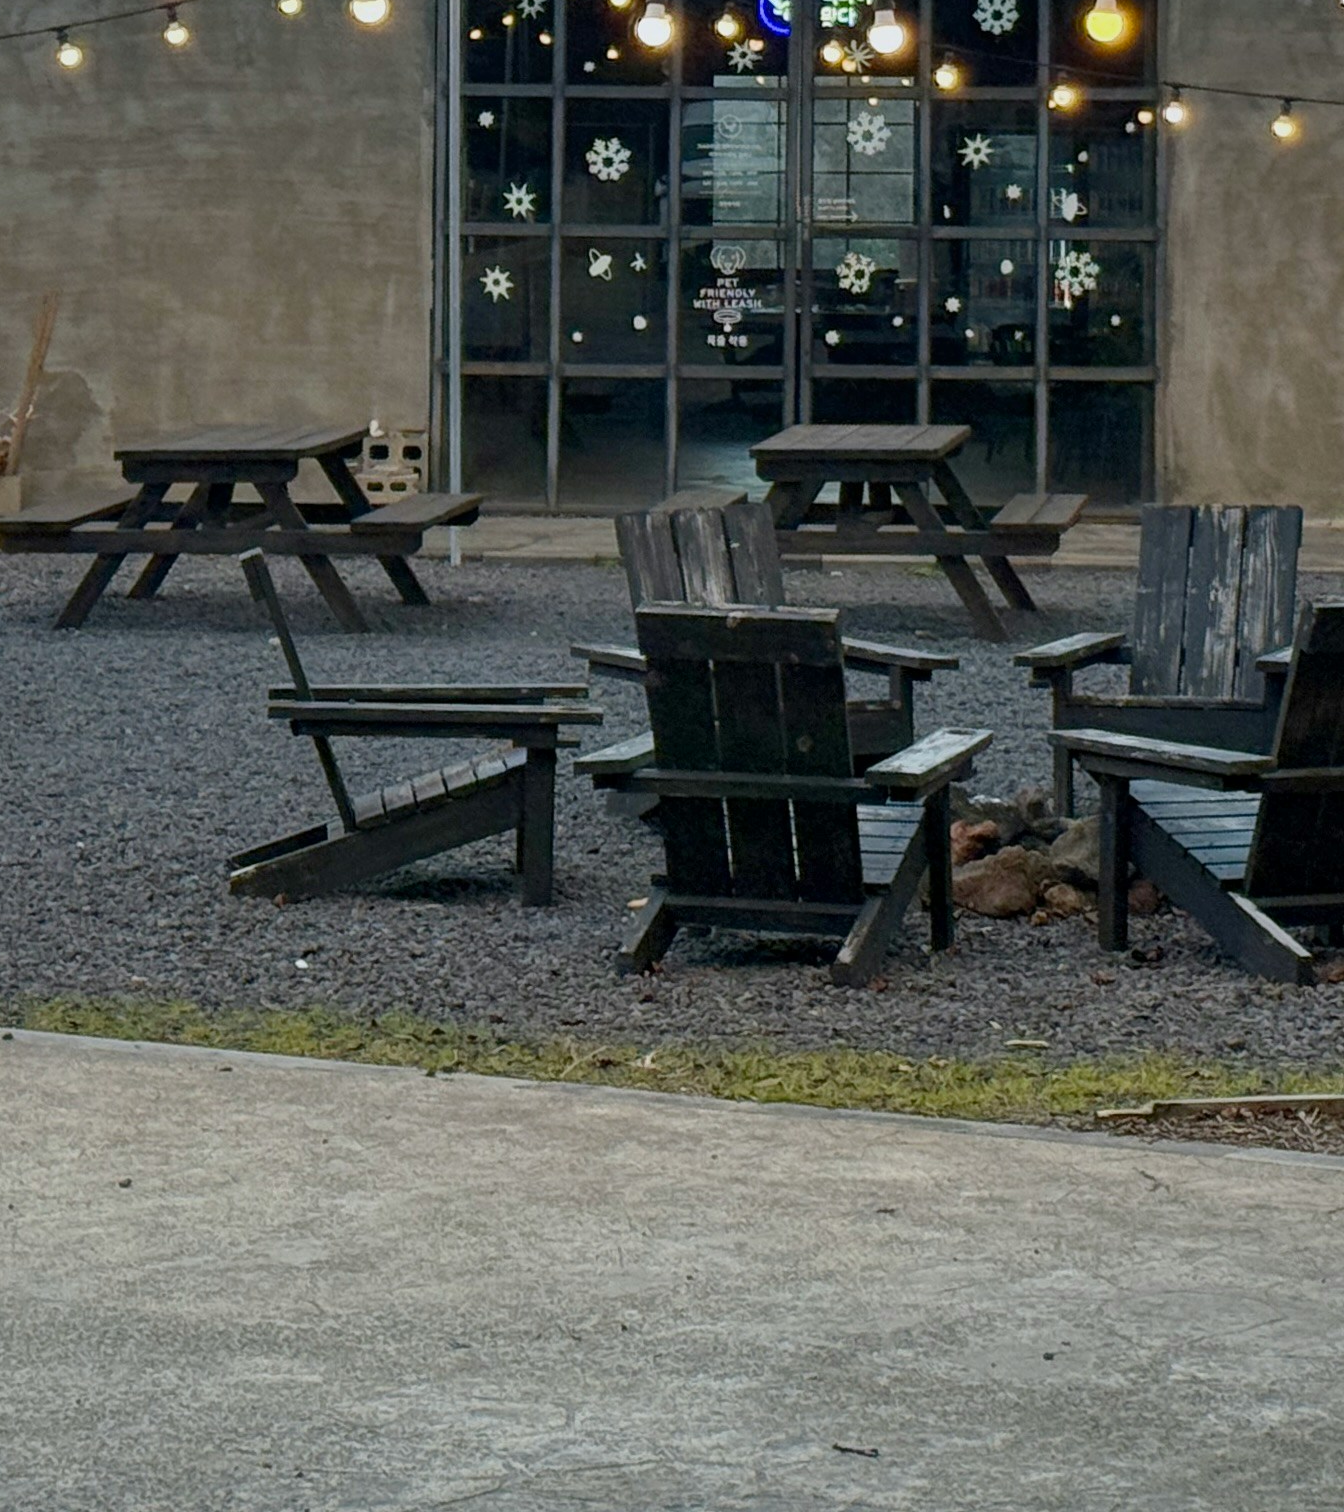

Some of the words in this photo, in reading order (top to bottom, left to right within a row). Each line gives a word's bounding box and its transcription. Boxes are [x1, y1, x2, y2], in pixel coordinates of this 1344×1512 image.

[717, 277, 739, 288] PET
[699, 288, 756, 299] FRIENDLY
[692, 298, 721, 309] WITH
[724, 298, 762, 309] LEASH
